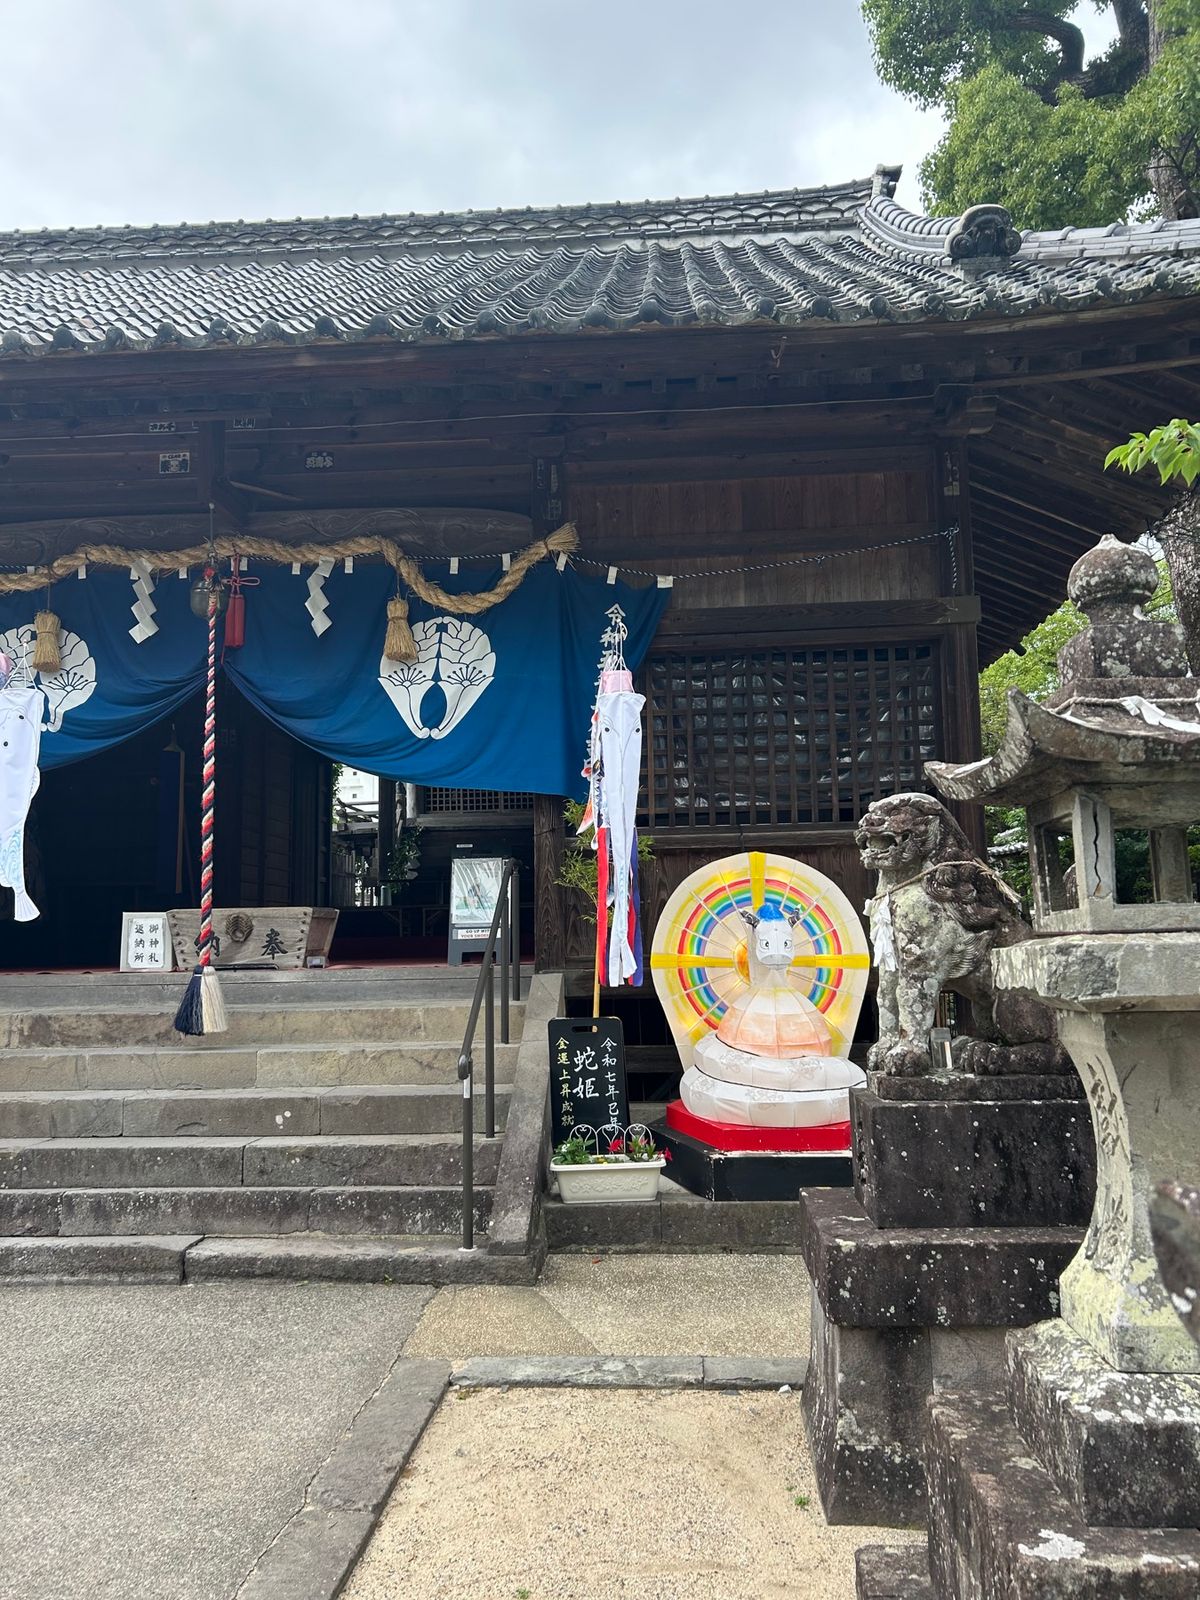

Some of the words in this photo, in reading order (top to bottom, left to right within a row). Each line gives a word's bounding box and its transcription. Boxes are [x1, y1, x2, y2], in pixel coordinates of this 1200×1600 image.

[134, 923, 145, 963] 返納所
[148, 923, 160, 963] 御神札
[555, 1037, 575, 1126] 金運上昇成就
[572, 1046, 600, 1099] 蛇姫
